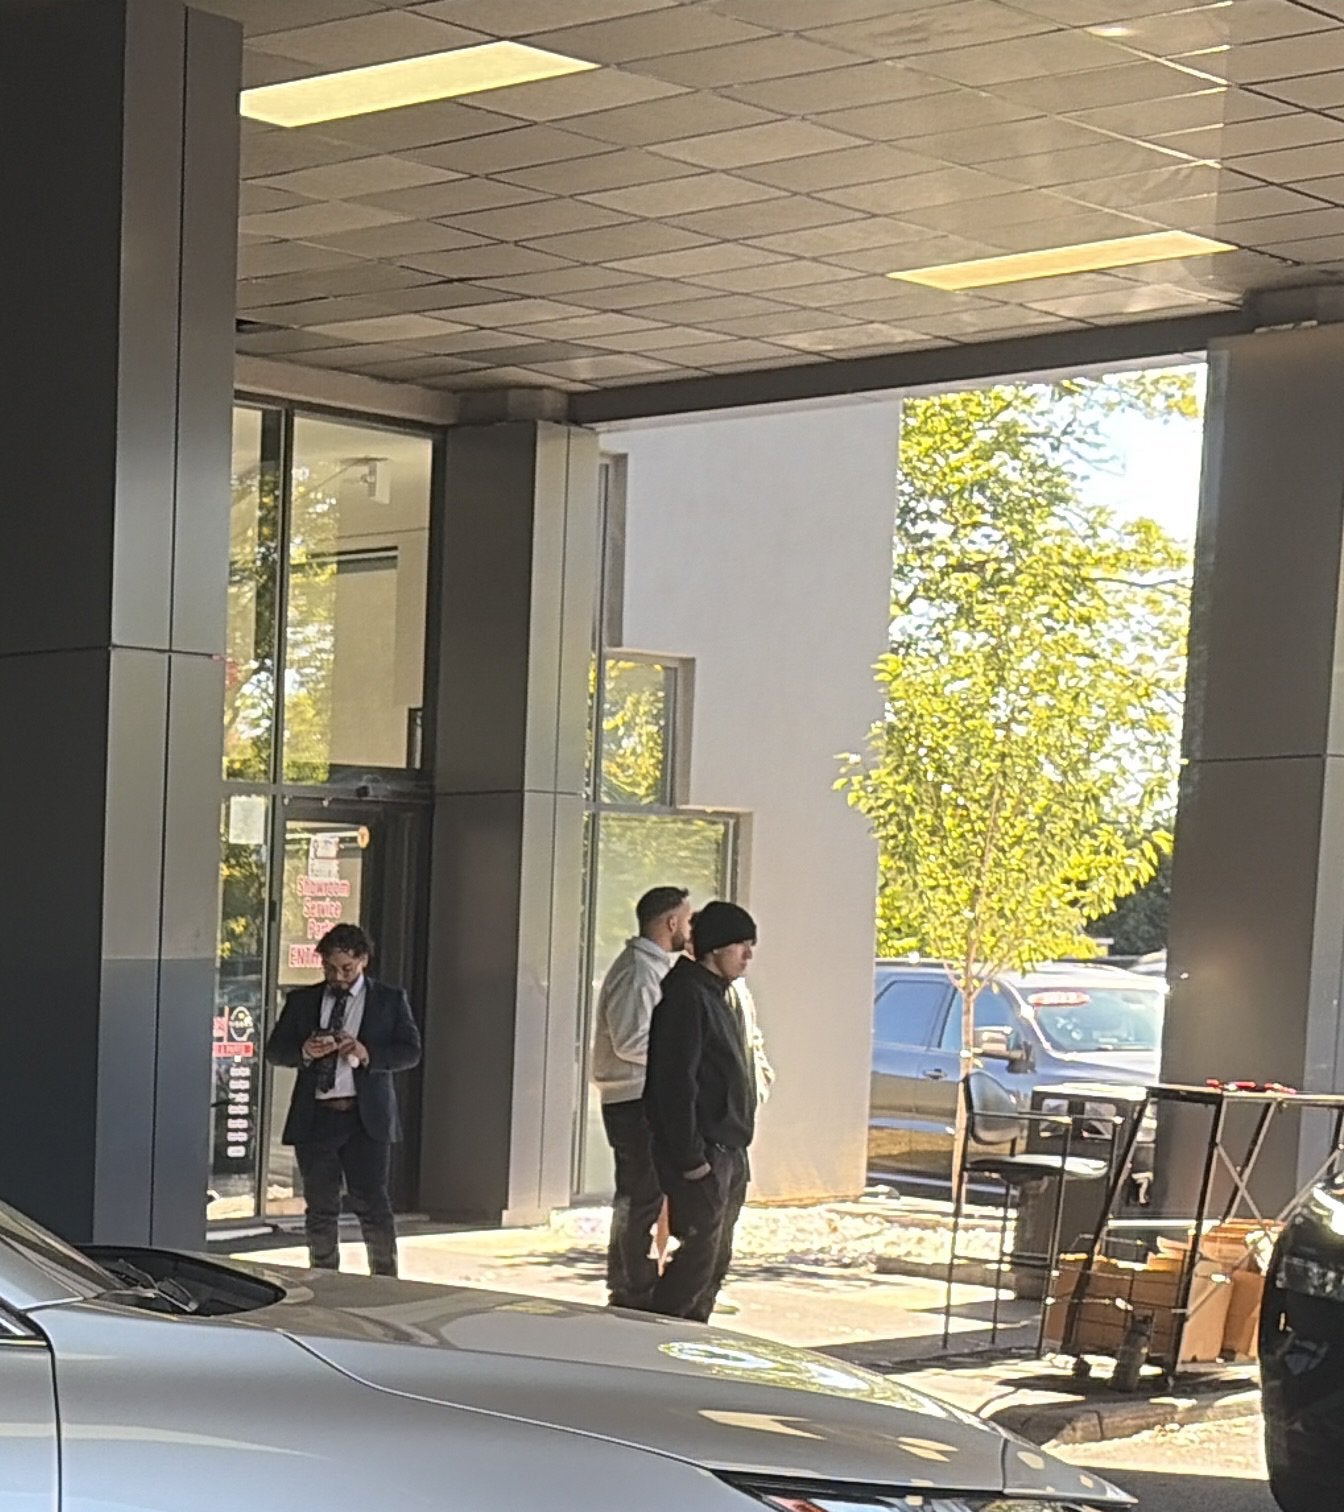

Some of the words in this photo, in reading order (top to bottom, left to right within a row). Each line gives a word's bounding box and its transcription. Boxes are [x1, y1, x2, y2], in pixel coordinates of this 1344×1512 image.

[296, 875, 351, 897] Showroom
[303, 897, 342, 918] Service
[307, 918, 335, 940] Part
